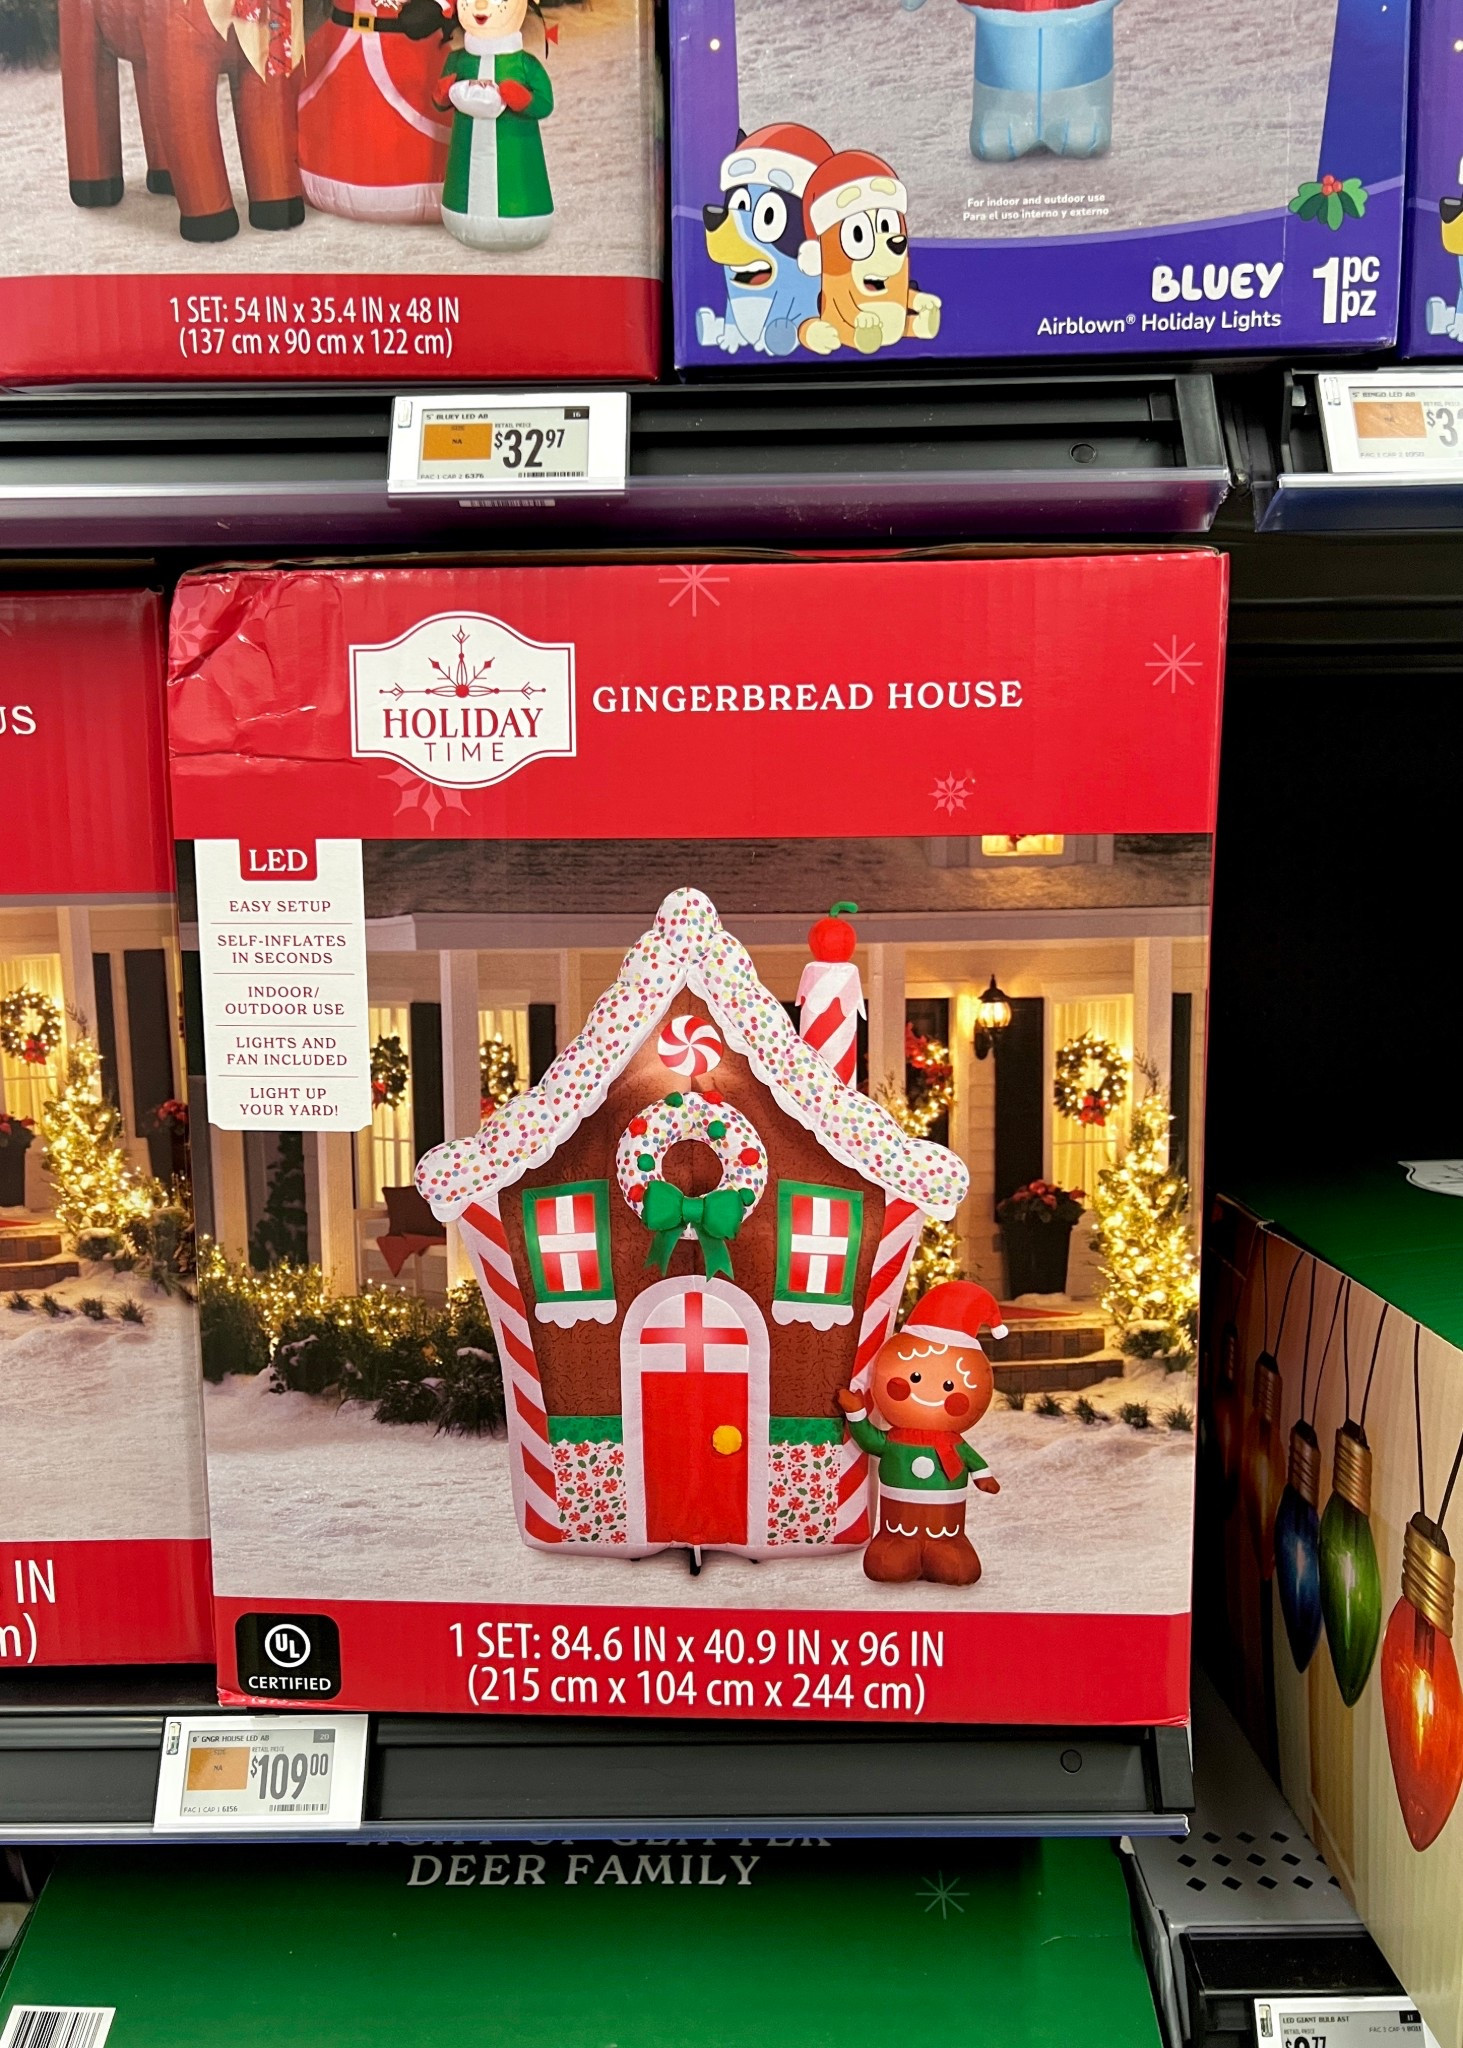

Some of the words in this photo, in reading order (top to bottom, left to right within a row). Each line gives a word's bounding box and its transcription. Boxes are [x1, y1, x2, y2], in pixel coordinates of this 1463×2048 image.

[967, 198, 984, 208] For
[987, 196, 1020, 206] indoor
[1022, 195, 1041, 205] and
[1044, 194, 1085, 205] outdoor
[1088, 194, 1105, 202] use
[963, 212, 985, 221] Para
[989, 211, 998, 220] el
[1002, 212, 1019, 220] uso
[1022, 209, 1058, 219] interno
[1061, 210, 1067, 219] y
[1070, 207, 1109, 217] externo
[1151, 262, 1285, 303] BLUEY
[1313, 256, 1340, 324] 1
[1342, 256, 1380, 289] pc
[170, 297, 180, 323] 1
[187, 296, 229, 323] SET:
[235, 297, 261, 323] 54
[266, 296, 287, 323] IN
[293, 303, 305, 323] x
[311, 297, 356, 324] 35.4
[362, 297, 383, 323] IN
[389, 303, 401, 323] x
[406, 297, 432, 323] 48
[438, 297, 459, 323] IN
[1341, 289, 1377, 323] pz
[1142, 311, 1215, 333] Holiday
[1221, 310, 1282, 331] Lights
[179, 327, 225, 358] (137
[232, 334, 262, 354] cm
[268, 334, 280, 354] x
[284, 329, 310, 354] 90
[316, 334, 347, 354] cm
[352, 334, 364, 354] x
[371, 329, 408, 354] 122
[414, 327, 453, 358] cm)
[592, 683, 873, 713] GINGERBREAD
[887, 680, 1023, 709] HOUSE
[382, 708, 544, 739] HOLIDAY
[424, 742, 504, 762] TIME
[248, 849, 309, 872] LED
[229, 900, 271, 913] EASY
[277, 900, 331, 913] SETUP
[217, 935, 347, 947] SELF-INFLATES
[232, 952, 249, 964] IN
[254, 952, 333, 964] SECONDS
[248, 986, 320, 998] INDOOR/
[225, 1003, 308, 1015] OUTDOOR
[313, 1003, 345, 1015] USE
[236, 1037, 297, 1049] LIGHTS
[302, 1037, 336, 1049] AND
[227, 1053, 258, 1065] FAN
[264, 1054, 347, 1066] INCLUDED
[250, 1087, 300, 1099] LIGHT
[306, 1087, 327, 1099] UP
[240, 1104, 284, 1116] YOUR
[289, 1104, 338, 1116] YARD!
[15, 1559, 56, 1604] IN
[275, 1633, 301, 1659] UL
[450, 1623, 464, 1658] 1
[477, 1621, 541, 1659] SET:
[551, 1625, 623, 1662] 84.6
[633, 1626, 666, 1662] IN
[677, 1635, 695, 1663] x
[703, 1628, 776, 1665] 40.9
[788, 1629, 820, 1665] IN
[831, 1638, 849, 1666] x
[858, 1631, 900, 1667] 96
[911, 1631, 944, 1667] IN
[248, 1675, 332, 1691] CERTIFIED
[468, 1664, 540, 1707] (215
[550, 1675, 598, 1703] cm
[608, 1676, 626, 1704] x
[637, 1670, 697, 1705] 104
[706, 1678, 754, 1706] cm
[764, 1679, 782, 1707] x
[792, 1673, 854, 1708] 244
[863, 1673, 926, 1716] cm)
[406, 1854, 547, 1886] DEER
[564, 1854, 761, 1886] FAMILY
